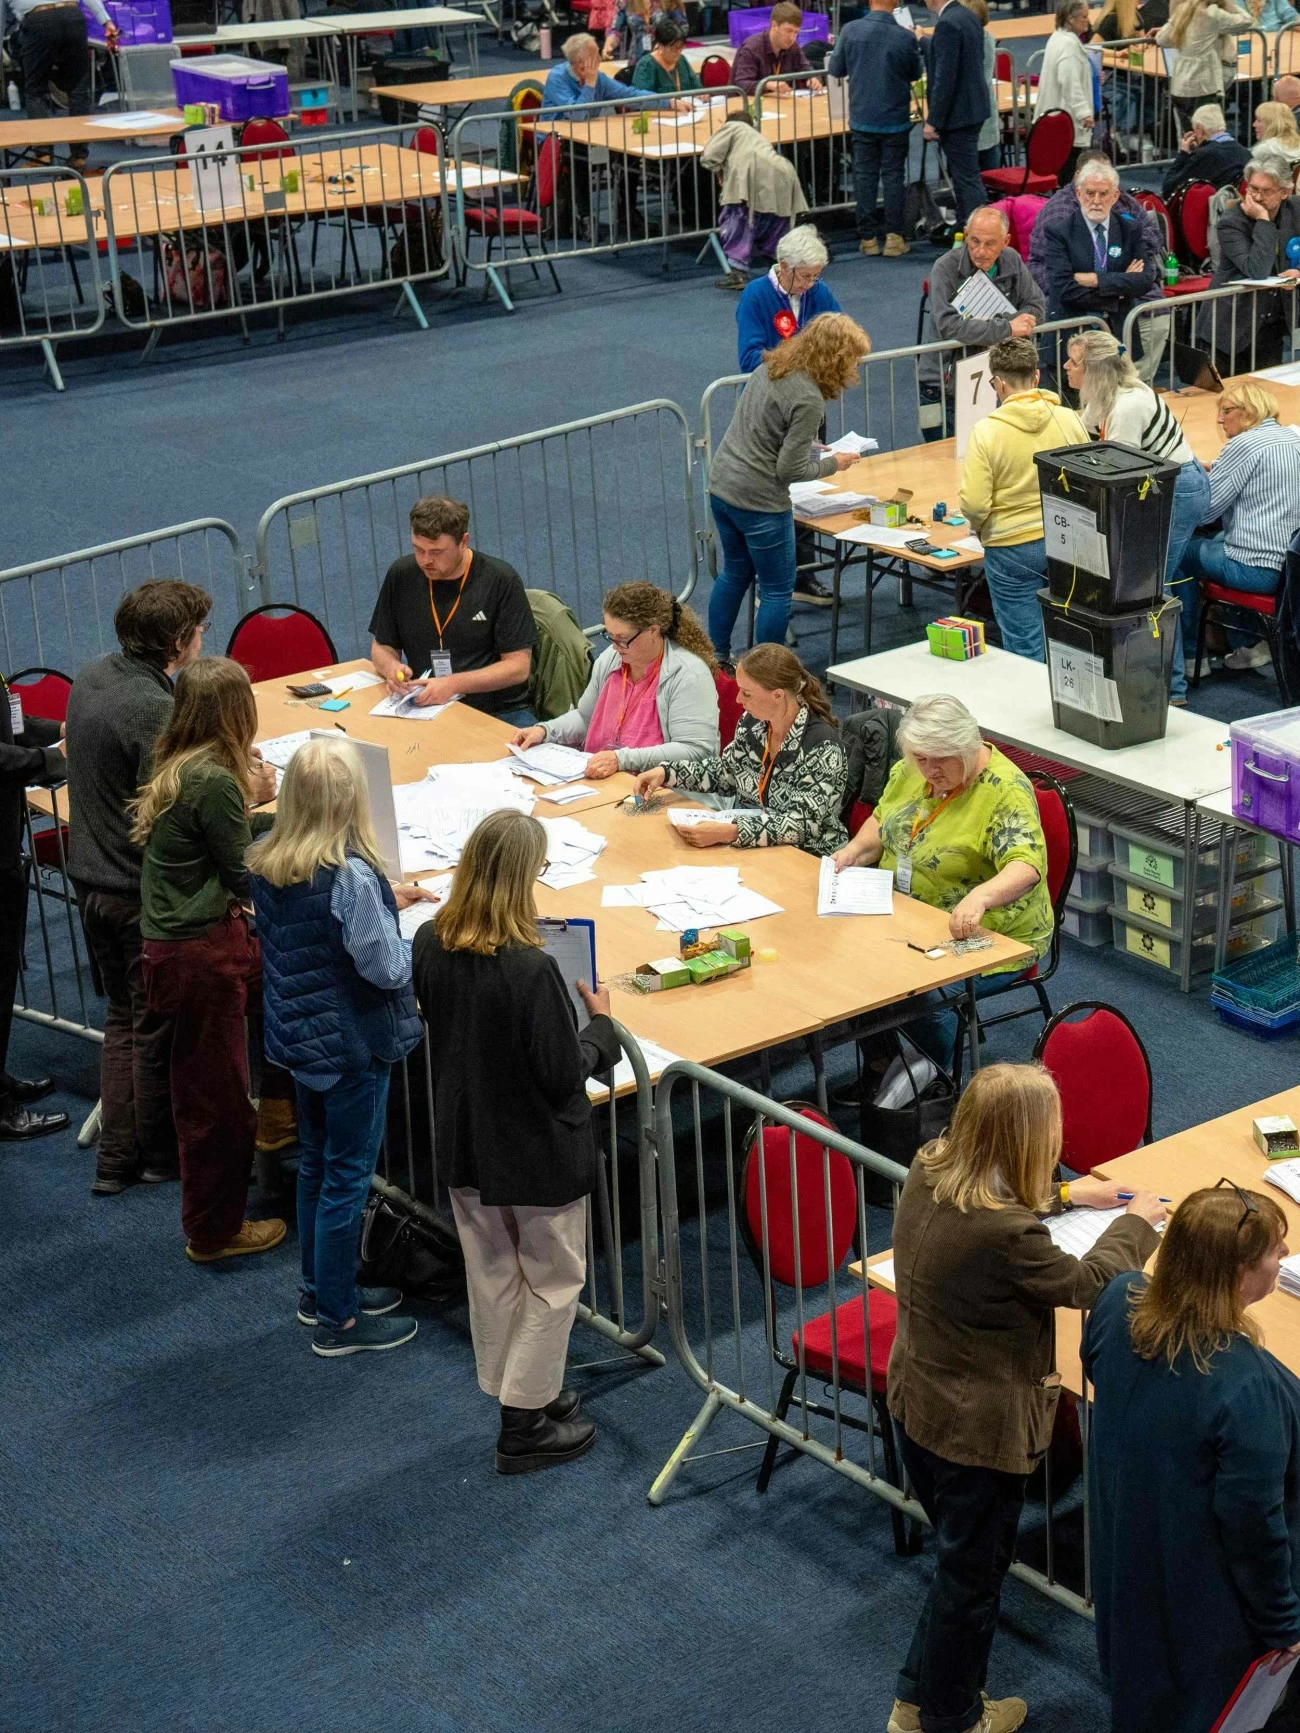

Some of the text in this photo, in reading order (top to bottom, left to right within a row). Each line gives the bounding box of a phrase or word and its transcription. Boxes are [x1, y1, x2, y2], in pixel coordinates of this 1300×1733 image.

[196, 141, 228, 170] 14
[971, 370, 983, 405] 7
[1054, 515, 1070, 527] CB-
[1061, 534, 1066, 544] 5
[1062, 657, 1075, 672] LK-
[1064, 676, 1074, 688] 26
